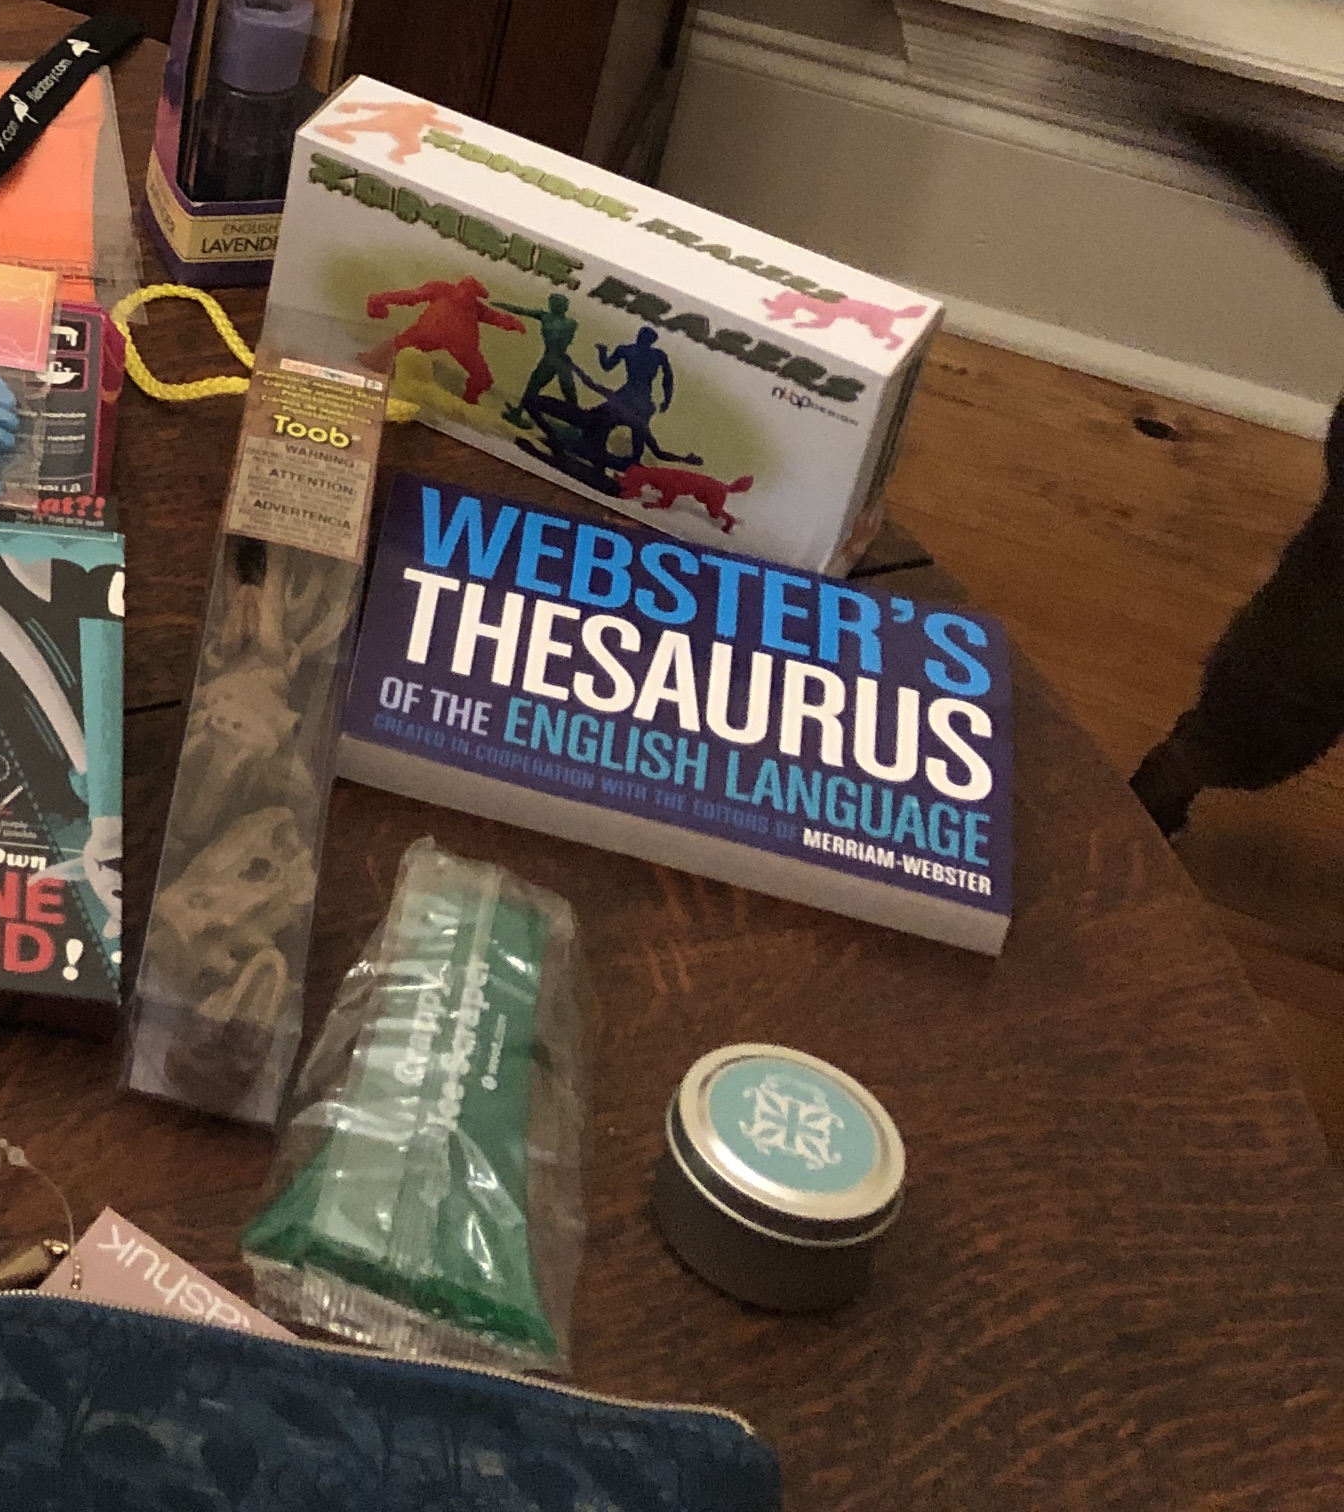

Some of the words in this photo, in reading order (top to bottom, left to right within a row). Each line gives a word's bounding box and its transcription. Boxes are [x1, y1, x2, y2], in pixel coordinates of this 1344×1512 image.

[308, 152, 584, 289] ZOMBIE
[586, 275, 864, 402] ERASERS
[422, 127, 638, 223] ZOMBIE
[639, 218, 848, 303] ERASERS
[253, 499, 352, 530] ADVERTENCIA
[269, 468, 354, 495] ATTENTION
[272, 414, 351, 448] Toob
[285, 444, 355, 469] WARNING
[420, 486, 992, 698] WEBSTER'S
[379, 676, 424, 715] OF
[429, 687, 492, 737] THE
[503, 697, 708, 792] ENGLISH
[724, 748, 992, 869] LANGUAGE
[403, 567, 994, 802] THESAURUS
[372, 714, 447, 749] CREATED
[452, 734, 469, 757] IN
[475, 740, 595, 789] COOPERATION
[600, 775, 647, 802] WITH
[654, 784, 686, 813] THE
[692, 799, 768, 836] EDITORS
[775, 823, 799, 841] OF
[802, 827, 992, 897] MERRIAM-WEBSTER
